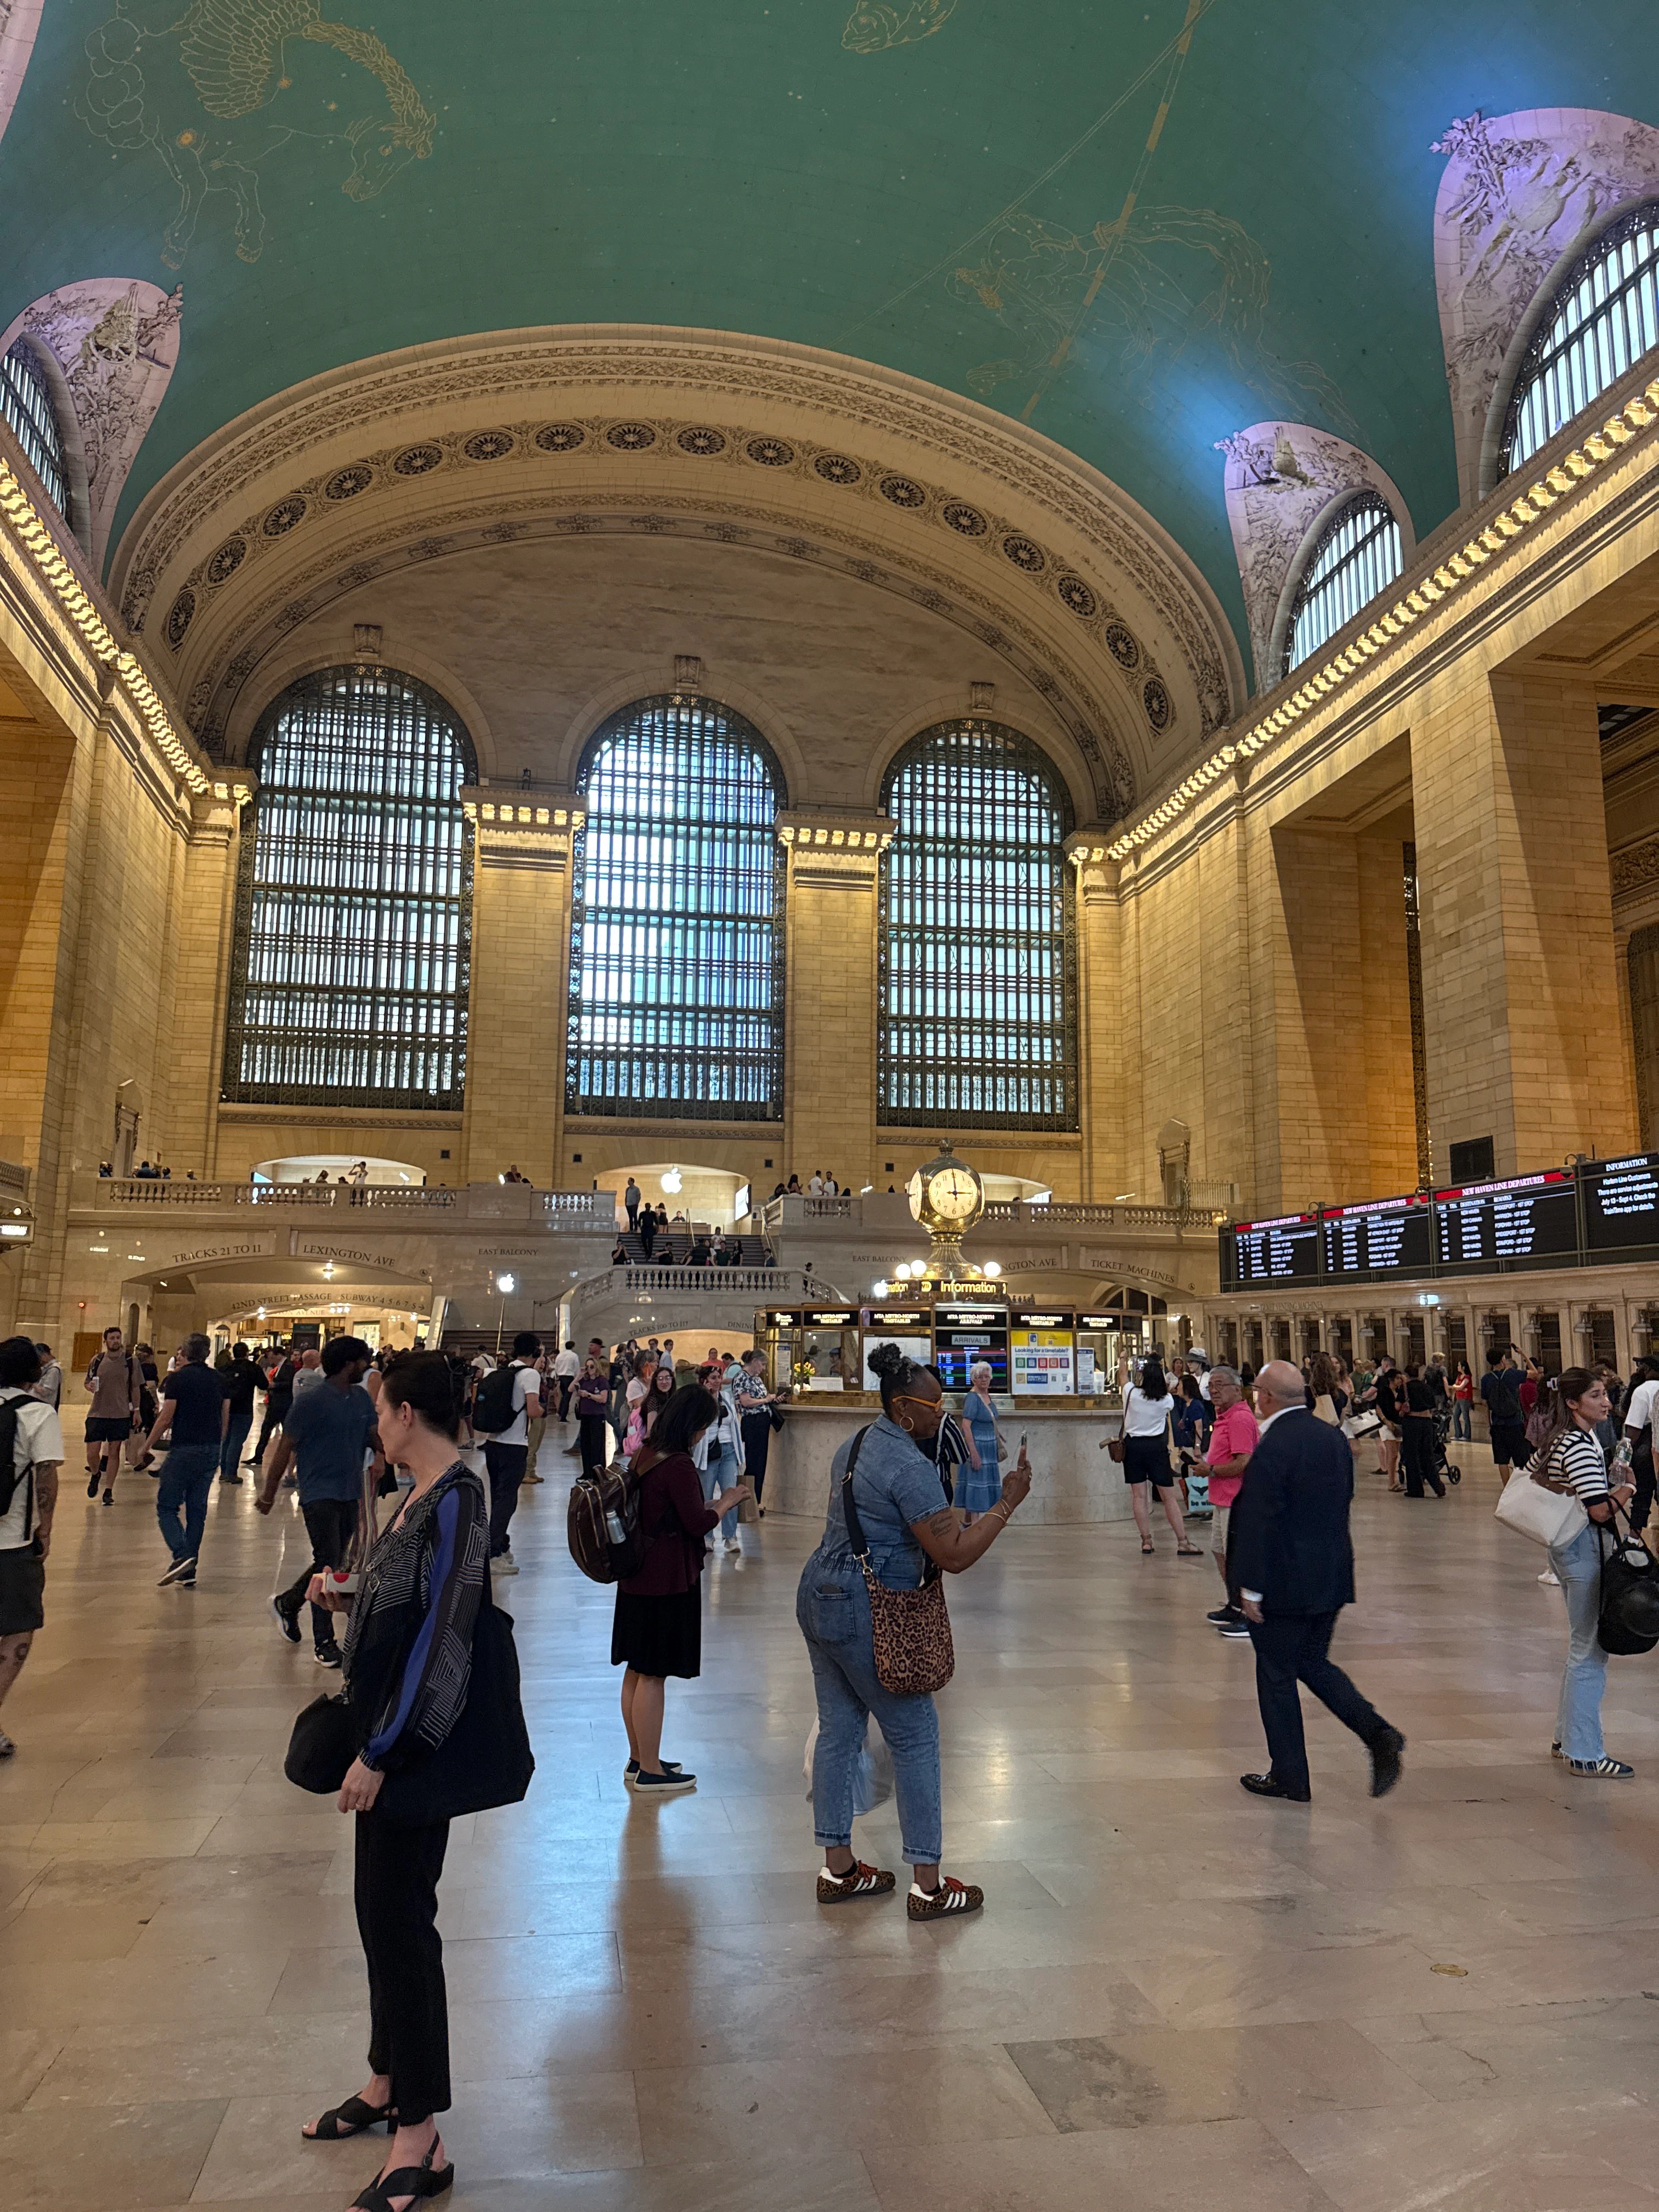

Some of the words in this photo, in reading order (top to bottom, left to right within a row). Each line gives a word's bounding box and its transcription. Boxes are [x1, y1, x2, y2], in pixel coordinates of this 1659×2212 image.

[1606, 1158, 1647, 1171] INFORMATION
[1462, 1187, 1474, 1196] NEW
[1475, 1184, 1494, 1193] HAVEN
[1494, 1182, 1508, 1190] LINE
[1508, 1175, 1545, 1188] DEPARTURES
[172, 1248, 217, 1262] TRACKS
[220, 1247, 230, 1255] 21
[234, 1245, 250, 1254] TO
[253, 1244, 261, 1252] 11
[303, 1245, 372, 1262] LEXINGTON
[374, 1256, 395, 1267] AVE
[1002, 1260, 1035, 1271] NGTON
[1091, 1260, 1124, 1269] TICKET
[1127, 1265, 1175, 1283] MACHINES
[940, 1281, 996, 1293] Information
[231, 1300, 255, 1310] 42ND
[257, 1295, 290, 1305] STREET
[292, 1293, 332, 1301] PASSAGE
[340, 1294, 378, 1303] SUBWAY
[629, 1326, 655, 1336] TRACKS
